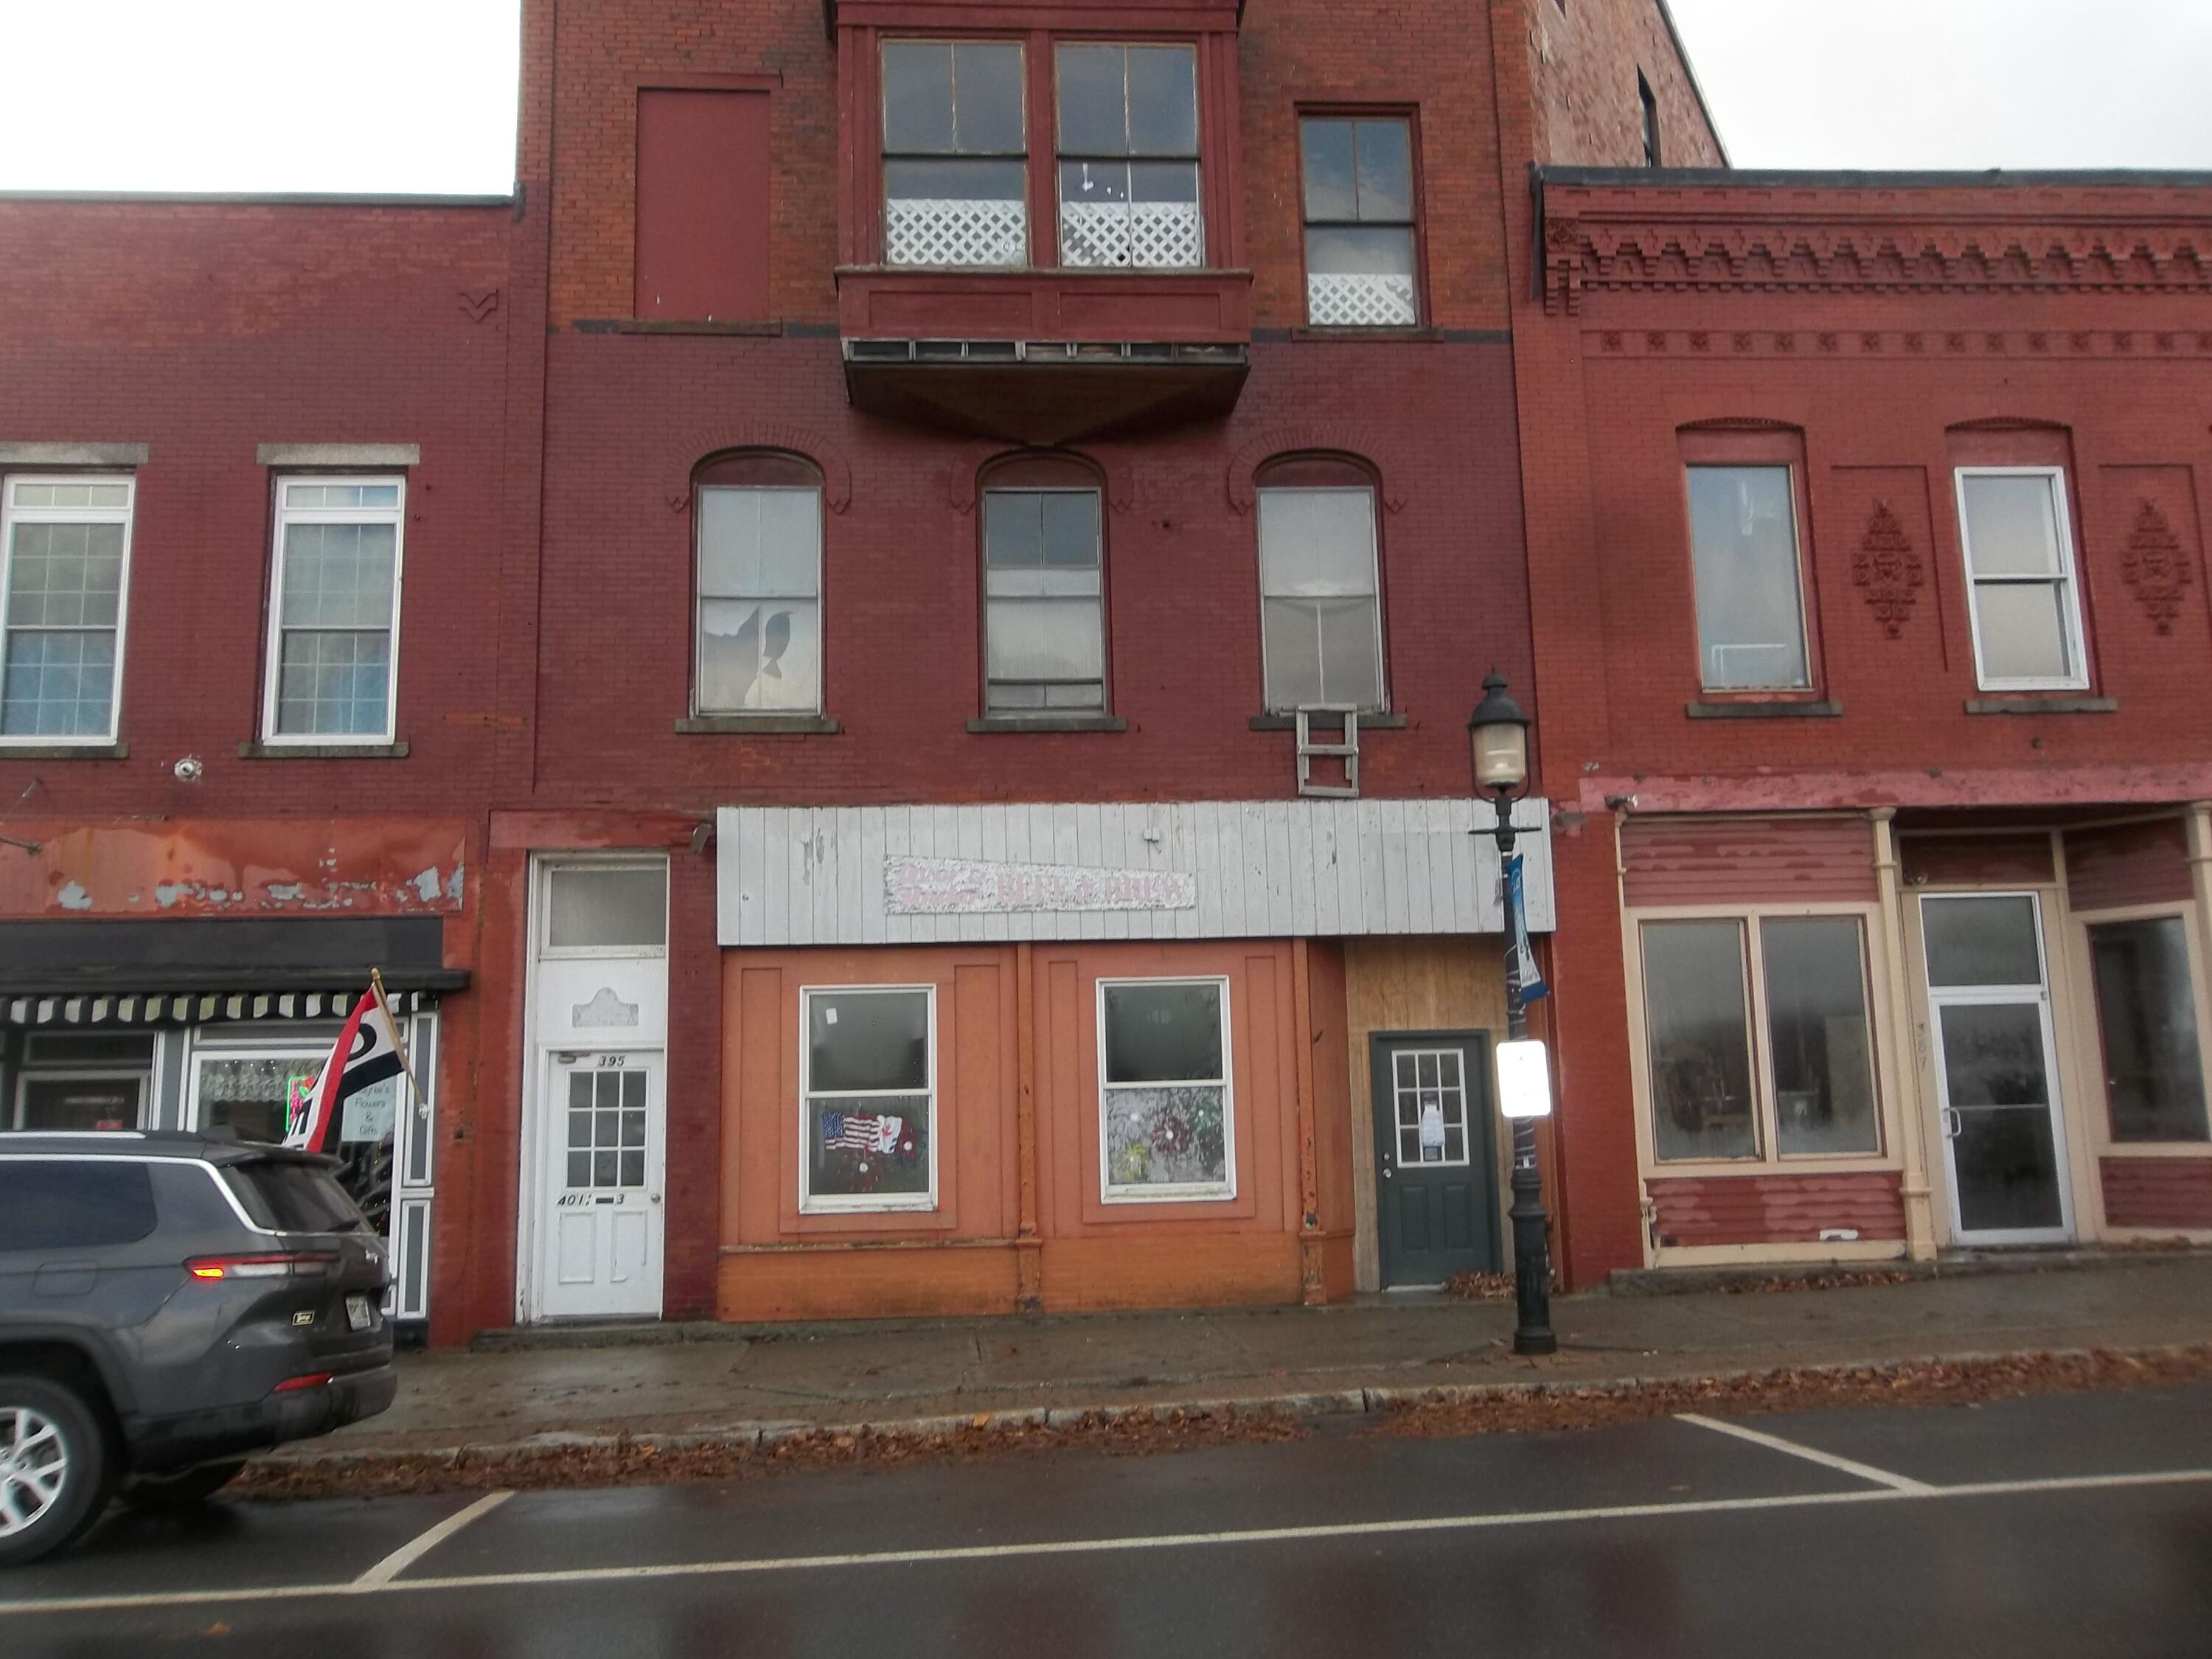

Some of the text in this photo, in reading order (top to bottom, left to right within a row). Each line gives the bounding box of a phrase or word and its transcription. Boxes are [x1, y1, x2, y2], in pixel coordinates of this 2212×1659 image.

[599, 1055, 625, 1067] 395
[355, 1097, 386, 1108] Flowers
[616, 1193, 625, 1205] 3
